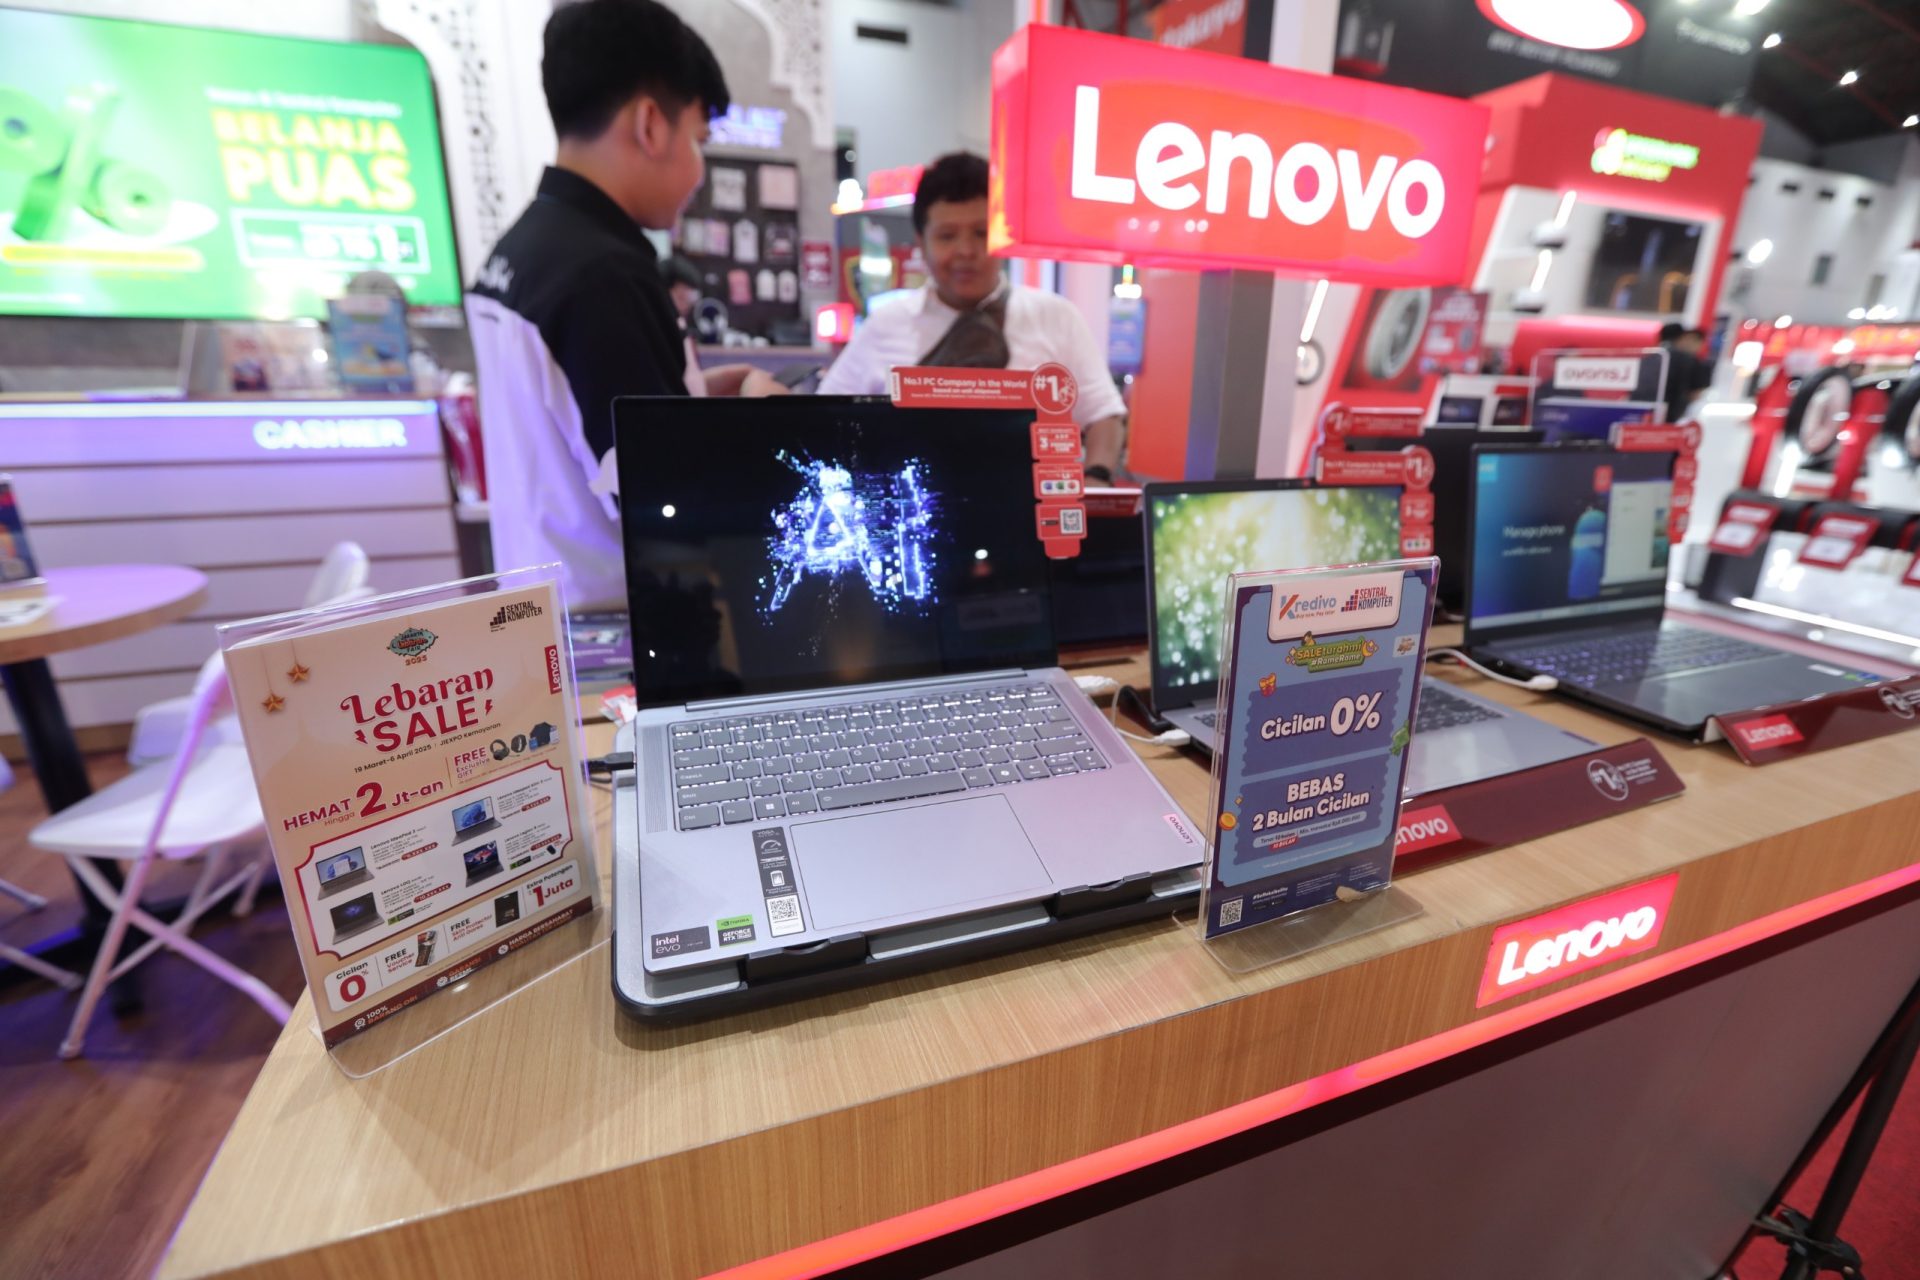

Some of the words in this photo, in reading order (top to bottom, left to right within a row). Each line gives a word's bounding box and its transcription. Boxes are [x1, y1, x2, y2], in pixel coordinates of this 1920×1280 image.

[1071, 85, 1445, 238] Lenovo
[221, 147, 416, 211] PUAS
[904, 377, 922, 385] No.1
[924, 378, 935, 386] PC
[937, 378, 976, 388] Company
[978, 378, 987, 387] in
[988, 378, 1001, 387] the
[1003, 379, 1027, 388] World
[1034, 375, 1059, 401] #1
[254, 420, 407, 450] CASHIER
[1040, 437, 1049, 449] 3
[1358, 596, 1393, 610] KOMPUTER
[1359, 586, 1387, 598] SENTRAL
[506, 600, 533, 613] SENTRAL
[507, 606, 543, 622] KOMPUTER
[1279, 594, 1336, 620] Kredivo
[405, 655, 427, 666] 2025
[549, 649, 561, 691] Lenovo
[340, 668, 494, 725] Lebaran
[373, 696, 478, 753] SALE
[1261, 714, 1325, 740] Cicilan
[1330, 691, 1382, 736] 0%
[397, 750, 413, 761] April
[415, 744, 432, 754] 2025
[440, 735, 462, 747] JIEXPO
[463, 723, 501, 739] Kemayoran
[1740, 722, 1794, 744] Lenovo
[454, 747, 487, 766] FREE
[456, 758, 490, 774] Exclusive
[1287, 773, 1344, 802] BEBAS
[283, 799, 351, 831] HEMAT
[356, 781, 387, 818] 2
[392, 781, 444, 807] Jt-an
[1252, 813, 1264, 831] 2
[1267, 804, 1313, 828] Bulan
[1317, 791, 1369, 815] Cicilan
[324, 811, 355, 826] Hingga
[1169, 816, 1193, 844] Lenovo
[526, 878, 543, 890] Extra
[544, 864, 573, 880] Potongan
[533, 885, 544, 908] 1
[545, 878, 573, 899] Juta
[450, 918, 470, 932] FREE
[655, 934, 679, 947] intel
[656, 944, 681, 954] evo
[1497, 906, 1657, 986] Lenovo
[385, 948, 407, 963] FREE
[336, 962, 369, 980] Cicilan
[367, 1005, 388, 1019] 100%
